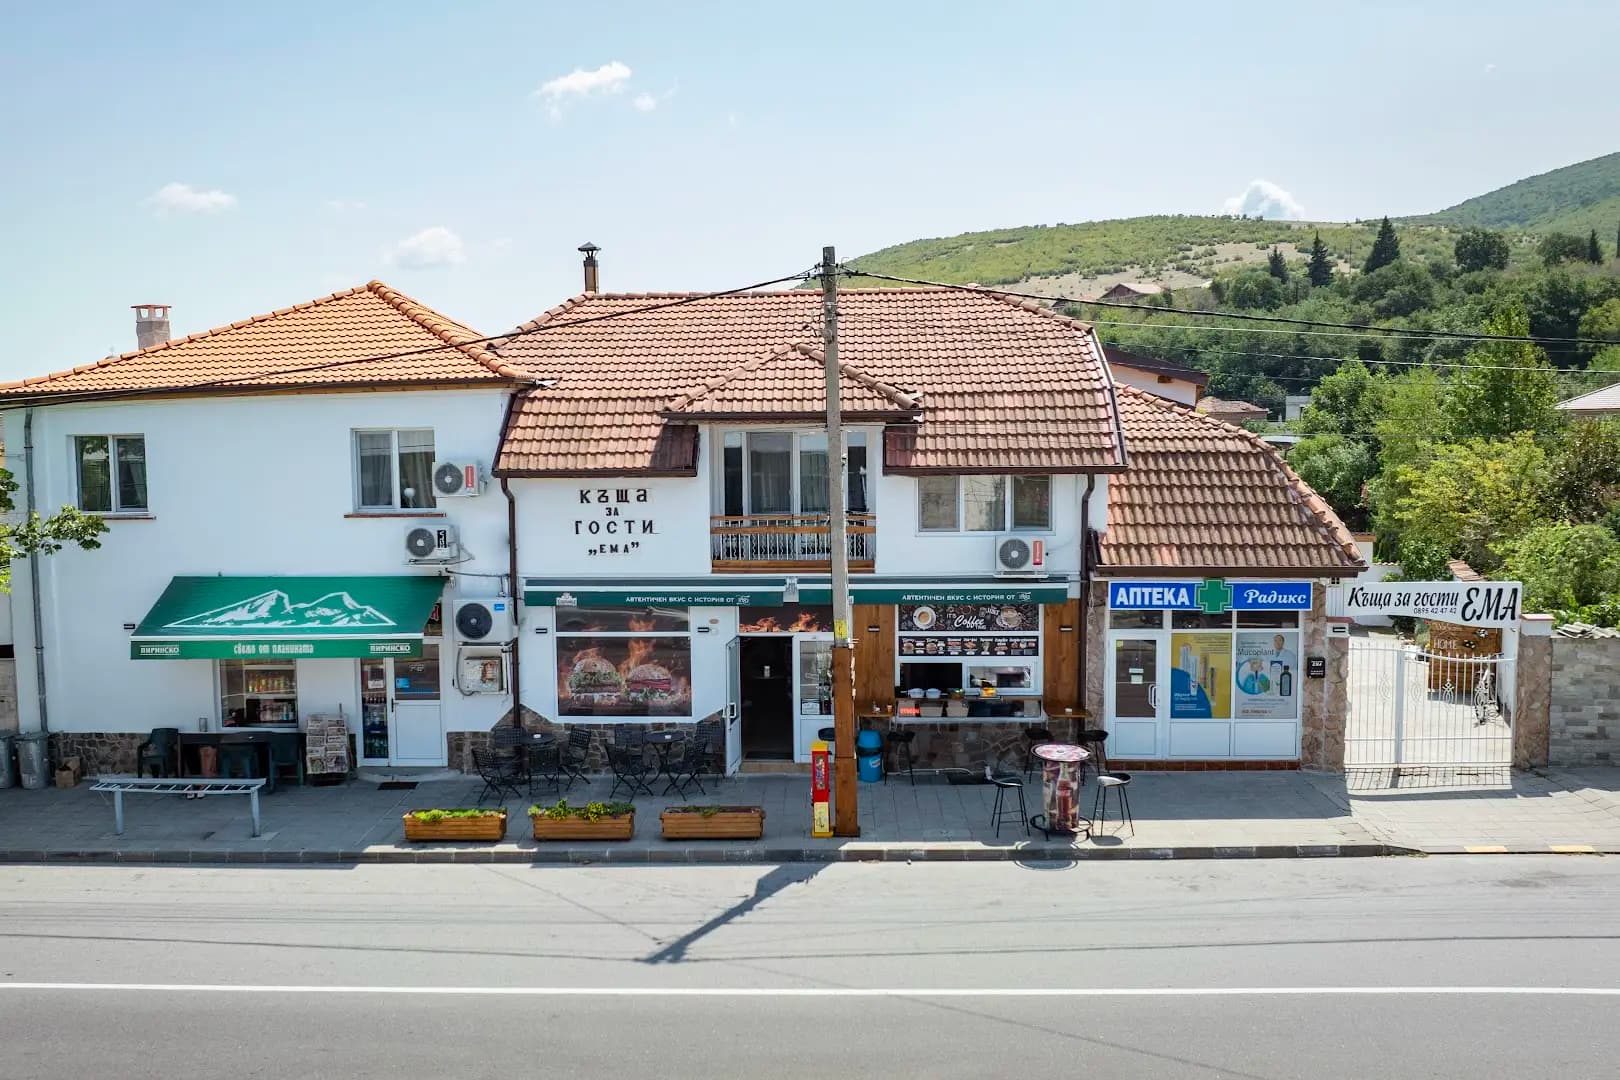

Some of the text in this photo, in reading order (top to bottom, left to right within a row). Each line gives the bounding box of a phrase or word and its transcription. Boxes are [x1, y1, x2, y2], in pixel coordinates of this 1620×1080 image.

[605, 506, 620, 517] ЗА
[575, 519, 654, 535] ГОСТИ
[1115, 587, 1190, 606] АПТЕКА
[1243, 589, 1307, 604] Радикс
[1347, 586, 1519, 622] Къща за гости ЕМА
[953, 614, 985, 629] Coffee
[370, 644, 411, 652] ПИРИНСКО
